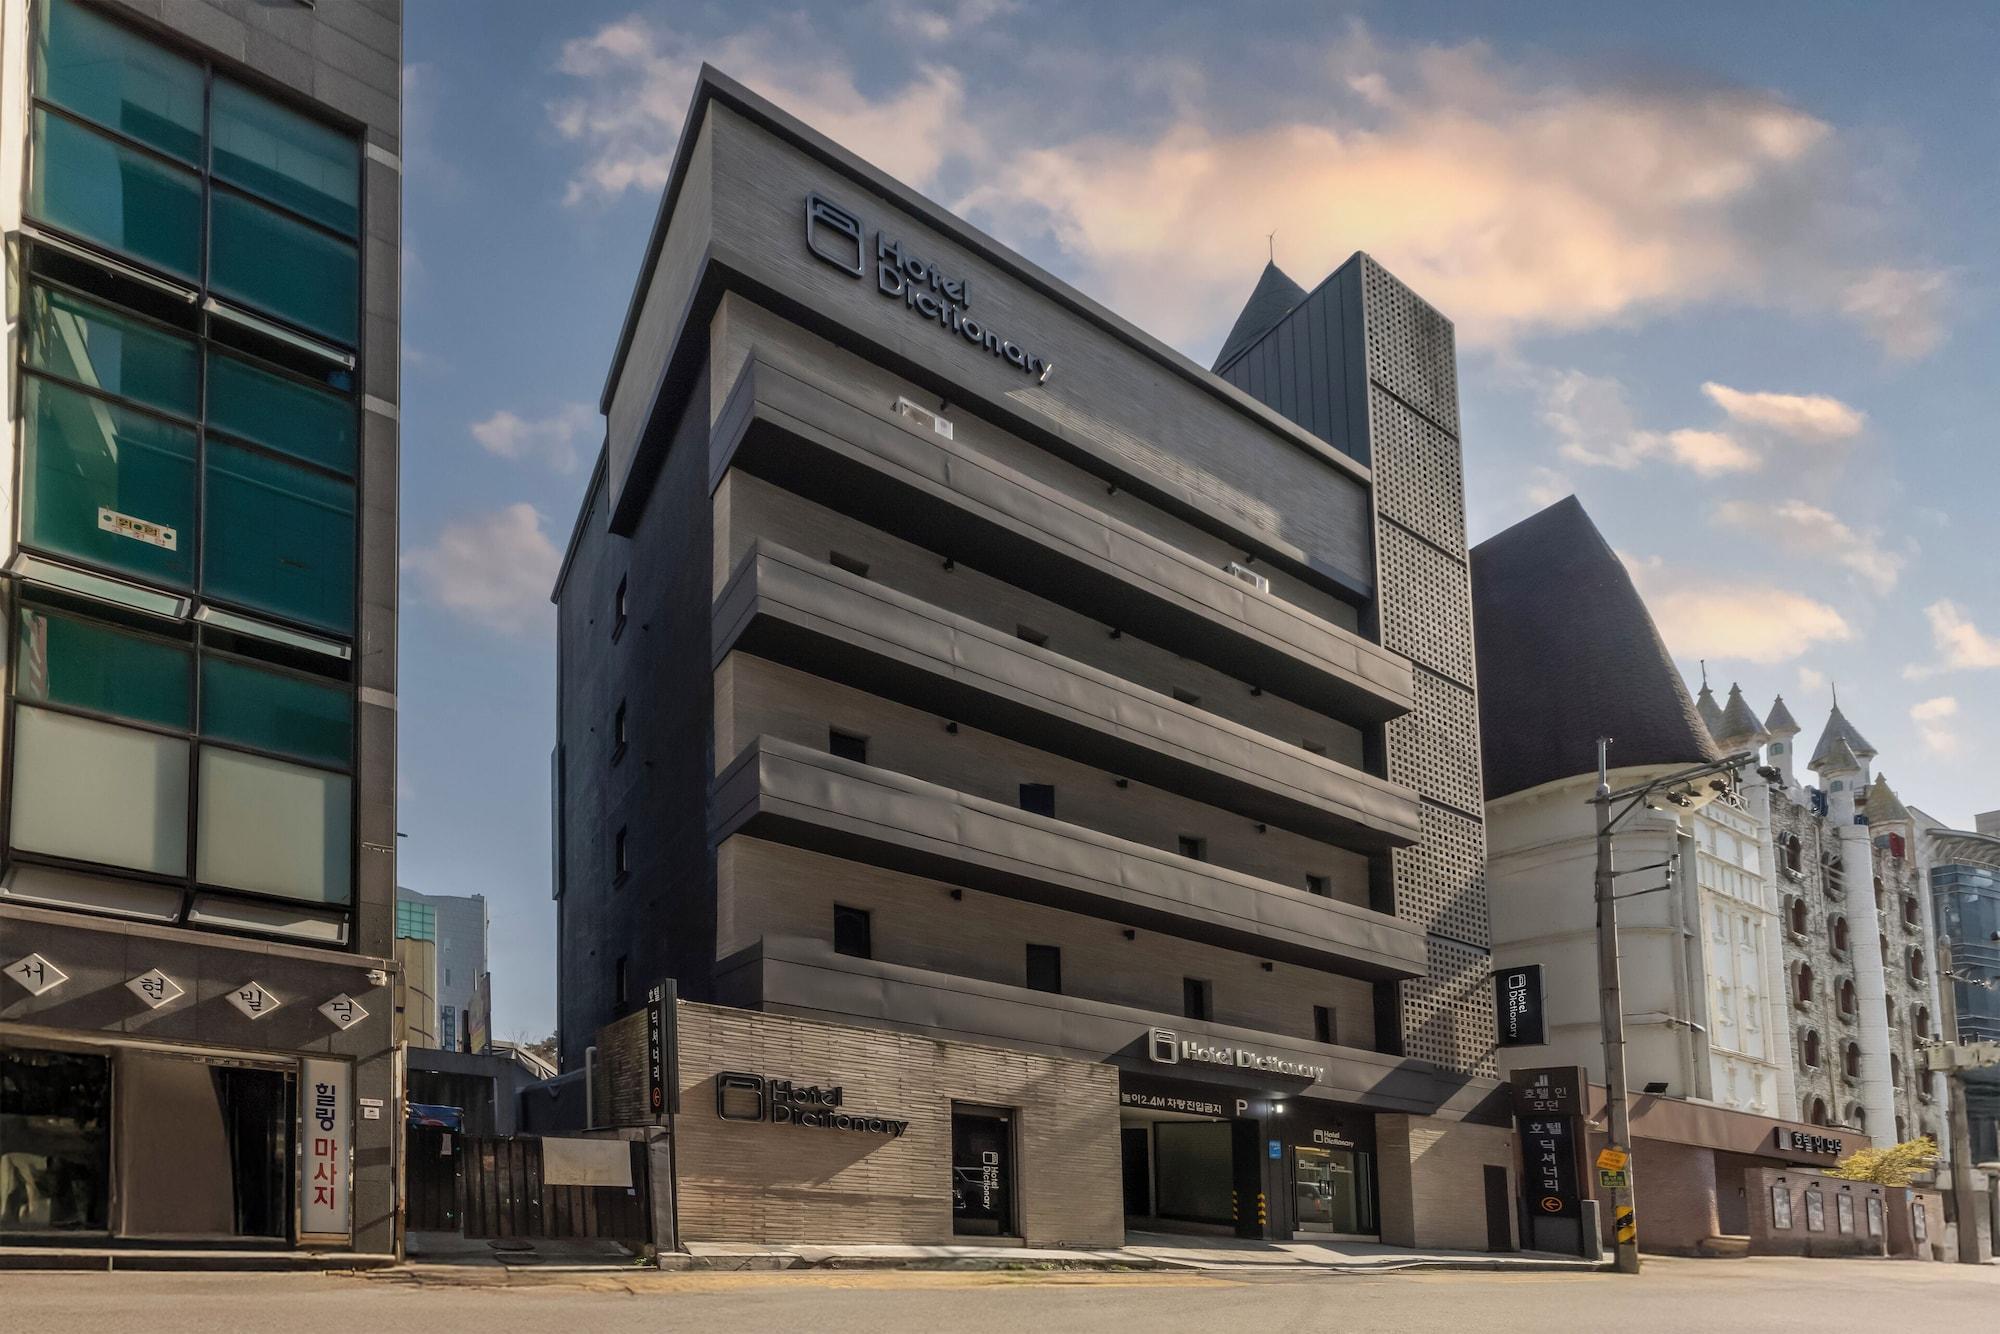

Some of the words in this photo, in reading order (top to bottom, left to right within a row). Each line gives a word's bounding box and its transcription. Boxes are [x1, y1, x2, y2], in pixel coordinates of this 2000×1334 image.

[876, 231, 973, 309] Hotel
[877, 260, 1052, 385] Dictionary
[1509, 990, 1518, 1038] Dictionary
[1518, 988, 1527, 1014] Hotel
[1181, 1040, 1233, 1066] Hotel
[1235, 1049, 1324, 1082] Dictionary
[315, 1083, 336, 1132] 힐링
[771, 1079, 843, 1107] Hotel
[1235, 1099, 1248, 1116] P
[1523, 1088, 1549, 1100] 호텔
[1554, 1087, 1567, 1099] 인
[1533, 1100, 1559, 1112] 모던
[771, 1102, 909, 1137] Dictionary
[1323, 1130, 1340, 1138] Hotel
[1528, 1122, 1562, 1135] 호텔
[1323, 1137, 1354, 1148] Dictionary
[313, 1138, 337, 1210] 마사지
[990, 1166, 999, 1189] Hotel
[1540, 1139, 1559, 1192] 딕셔너리
[982, 1165, 991, 1210] Dictionary
